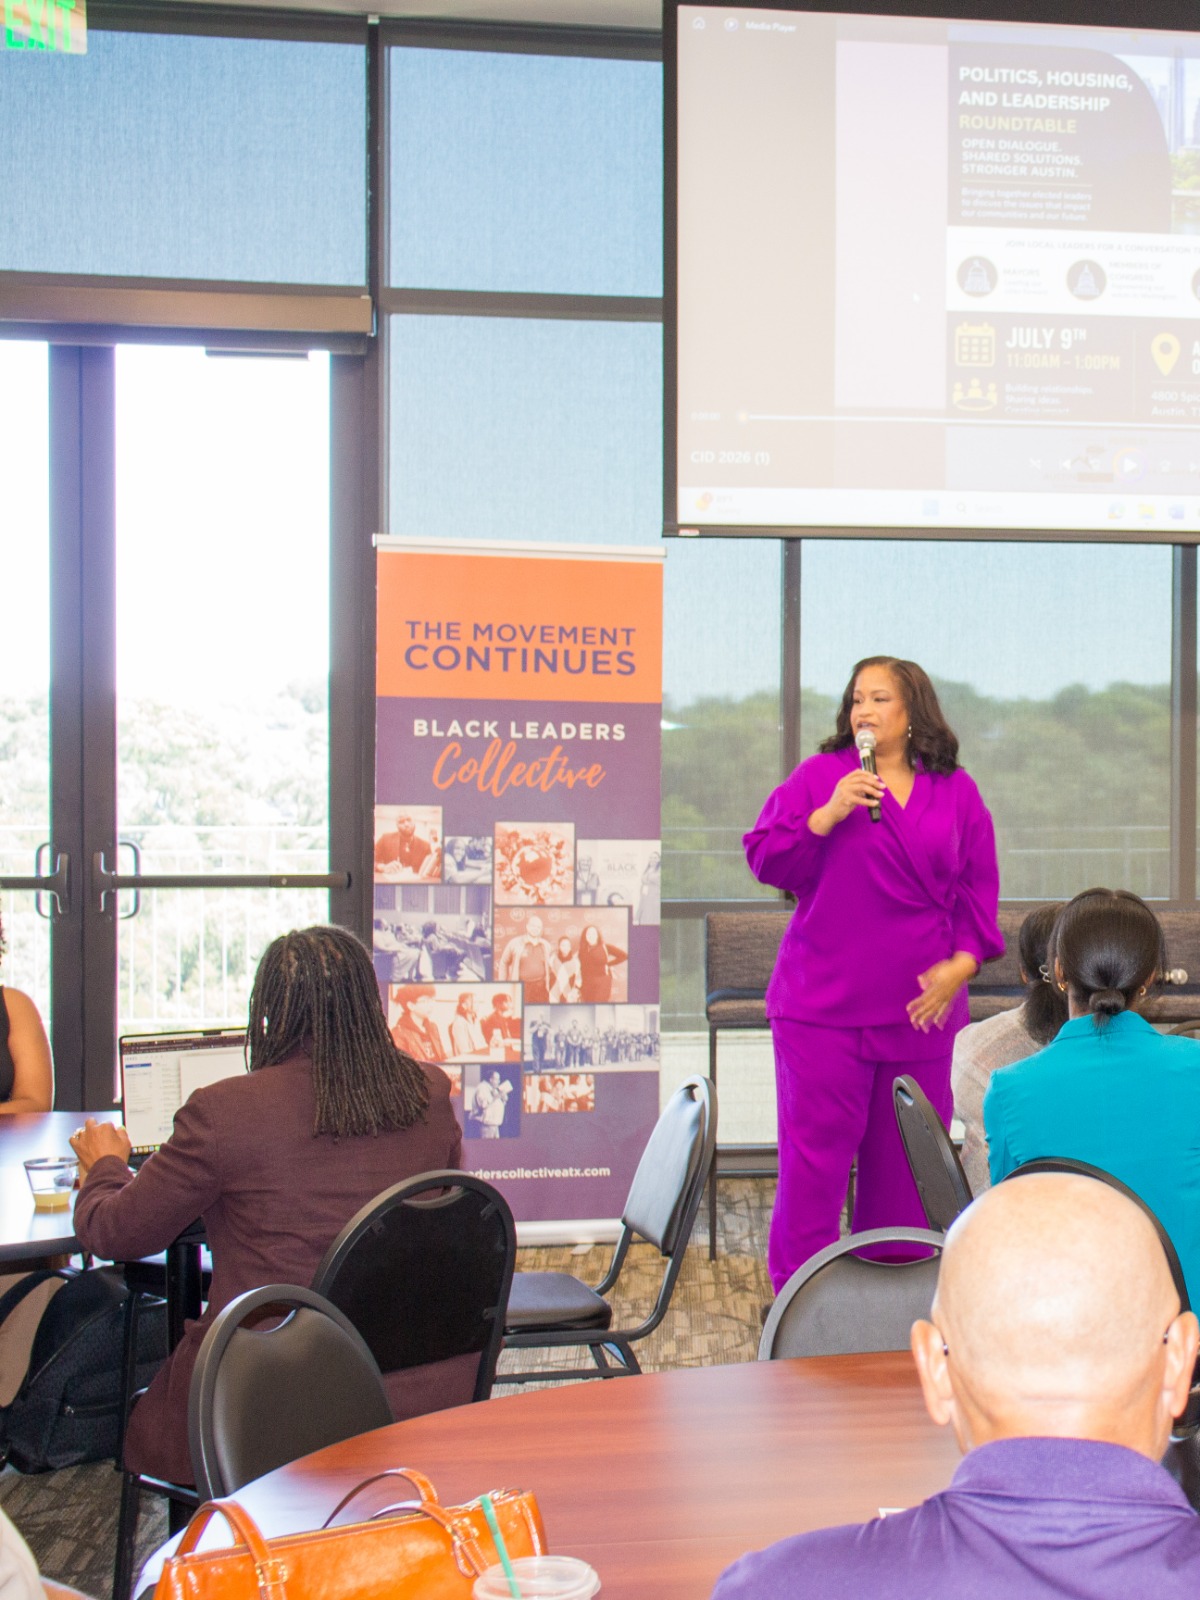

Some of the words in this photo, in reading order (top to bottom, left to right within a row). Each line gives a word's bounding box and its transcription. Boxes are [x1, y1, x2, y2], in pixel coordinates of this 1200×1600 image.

[5, 0, 72, 52] EXIT
[745, 21, 771, 31] Media
[772, 22, 797, 33] Player
[959, 66, 1043, 88] POLITICS,
[1046, 71, 1133, 93] HOUSING,
[959, 91, 999, 107] AND
[1002, 92, 1111, 112] LEADERSHIP
[959, 114, 1077, 134] ROUNDTABLE
[962, 138, 995, 150] OPEN
[998, 139, 1063, 153] DIALOGUE.
[962, 150, 1010, 163] SHARED
[1013, 152, 1084, 166] SOLUTIONS.
[962, 163, 1027, 177] STRONGER
[1030, 165, 1079, 179] AUSTIN.
[1005, 240, 1025, 249] JOIN
[1027, 241, 1055, 249] LOCAL
[1057, 242, 1095, 251] LEADERS
[1124, 244, 1192, 254] CONVERSATION
[1005, 327, 1054, 349] JULY
[1061, 328, 1087, 350] 9TH
[1007, 353, 1060, 369] 11:00AM
[1075, 354, 1121, 371] 1:00PM
[1151, 389, 1178, 402] 4800
[691, 450, 715, 464] CID
[718, 450, 752, 464] 2026
[755, 451, 771, 466] (1)
[405, 621, 461, 641] THE
[473, 623, 636, 647] MOVEMENT
[404, 644, 636, 676] CONTINUES
[413, 719, 499, 738] BLACK
[510, 721, 626, 741] LEADERS
[432, 738, 607, 798] Collective
[470, 1166, 611, 1180] derscollectiveatx.com
